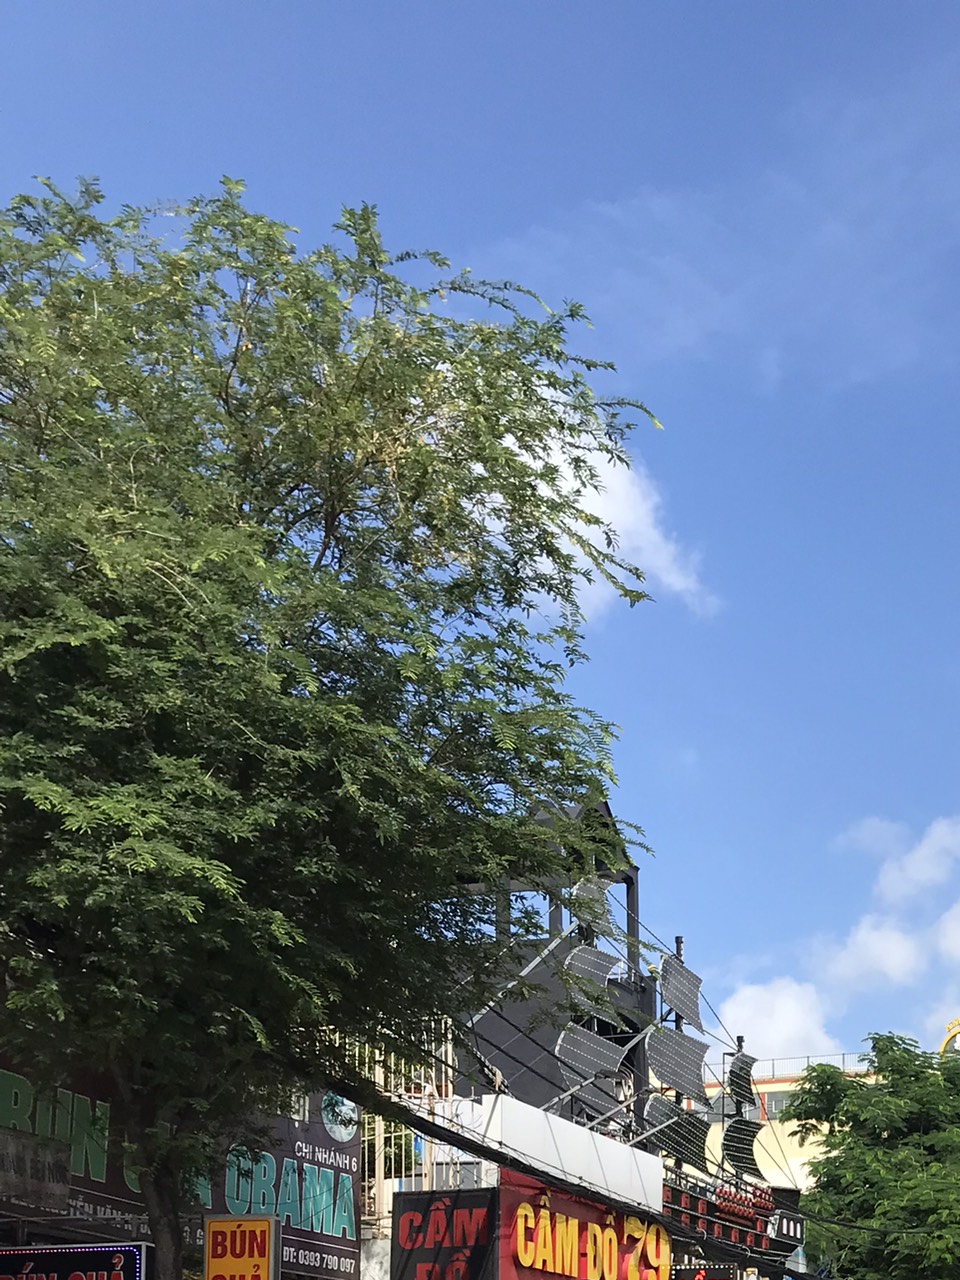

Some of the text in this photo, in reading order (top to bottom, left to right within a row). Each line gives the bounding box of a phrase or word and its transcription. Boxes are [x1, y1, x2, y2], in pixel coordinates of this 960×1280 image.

[294, 1141, 358, 1172] CHI NHÁNH 6
[225, 1143, 357, 1241] OBAMA
[211, 1223, 268, 1259] BÚN
[398, 1197, 489, 1250] CẦM
[516, 1192, 579, 1279] CẦM
[283, 1245, 356, 1274] ĐT: 0393 790 097
